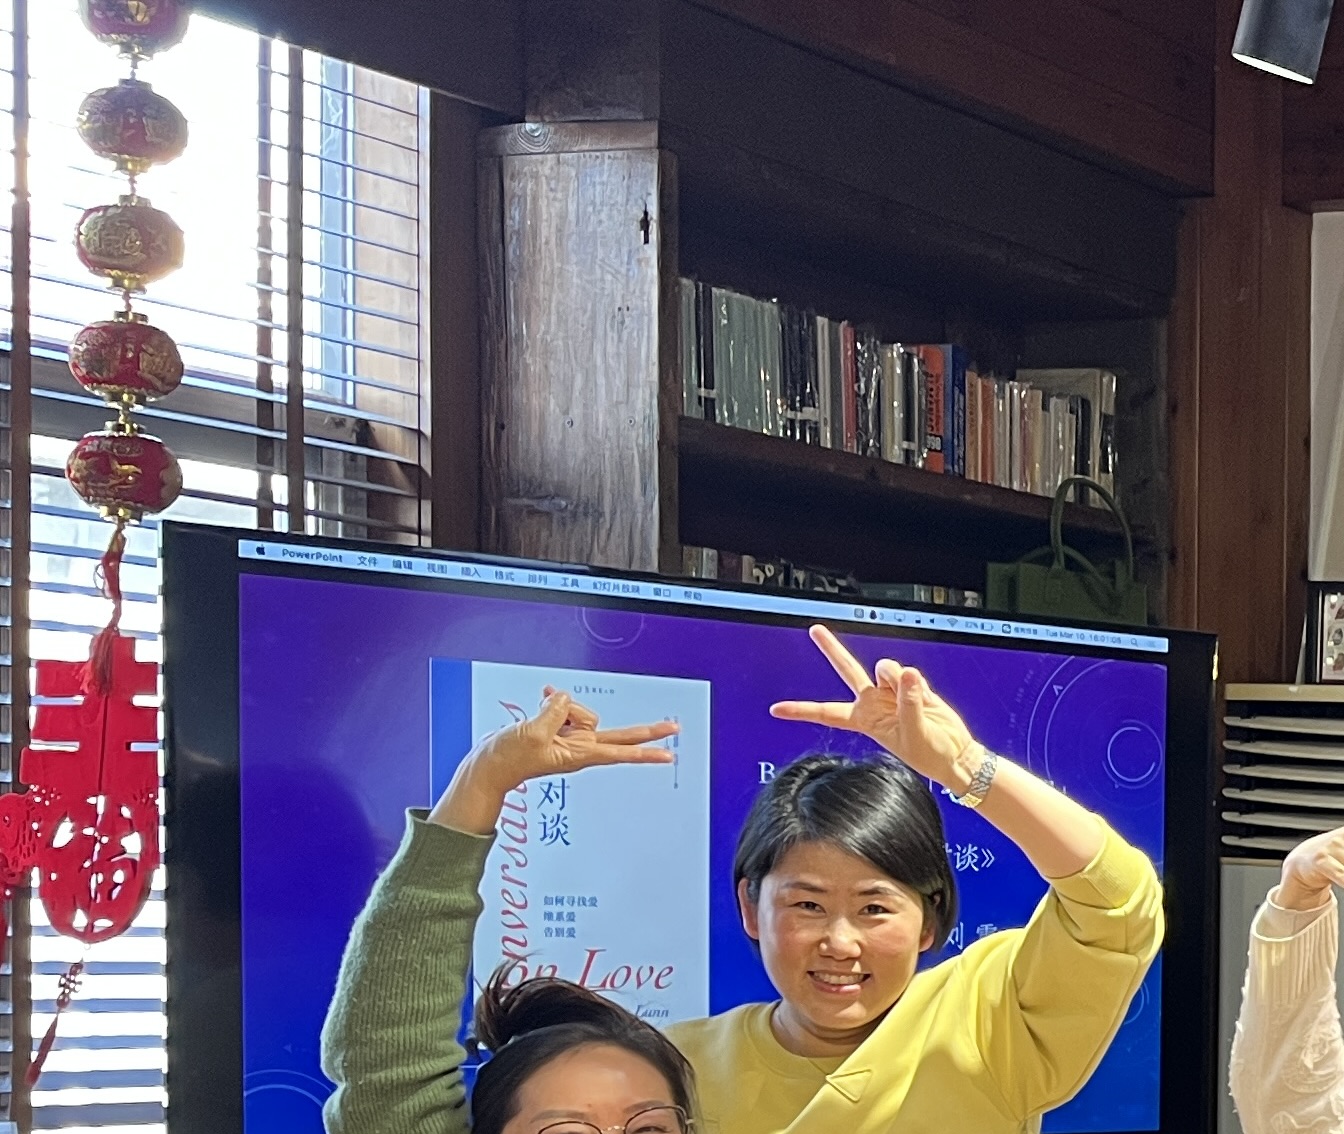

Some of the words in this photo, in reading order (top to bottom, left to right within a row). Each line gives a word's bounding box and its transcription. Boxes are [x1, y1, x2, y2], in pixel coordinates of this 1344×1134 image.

[281, 548, 343, 563] PowerPoint
[357, 555, 377, 567] 文件
[560, 576, 580, 589] 工具
[537, 776, 571, 848] 对谈
[543, 895, 598, 907] 如何寻找爱
[543, 911, 576, 923] 维系爱
[543, 927, 576, 938] 告别爱
[579, 947, 674, 991] Love
